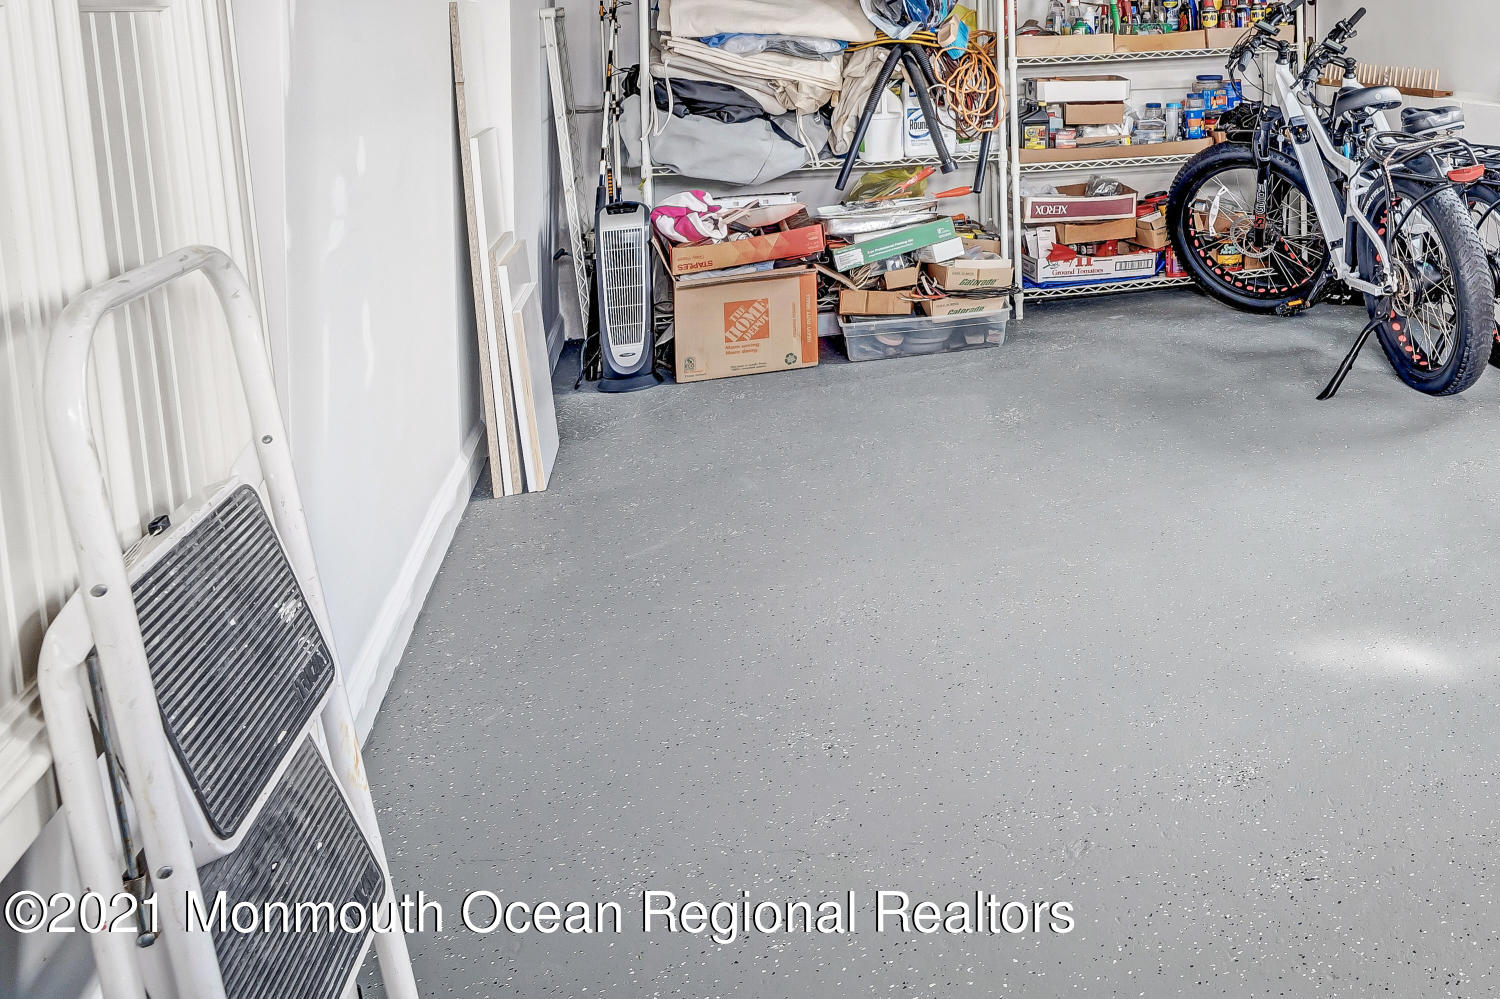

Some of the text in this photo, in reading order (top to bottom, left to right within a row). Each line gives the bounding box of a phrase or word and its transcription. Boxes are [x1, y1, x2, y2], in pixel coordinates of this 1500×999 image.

[1035, 204, 1068, 215] XEROX
[677, 260, 713, 271] STAPLES
[1052, 267, 1104, 276] Ground Tomatoes
[959, 278, 997, 286] Gatorade
[947, 306, 985, 315] Gatorade
[725, 299, 769, 342] HOME
[742, 312, 769, 341] DEPOT
